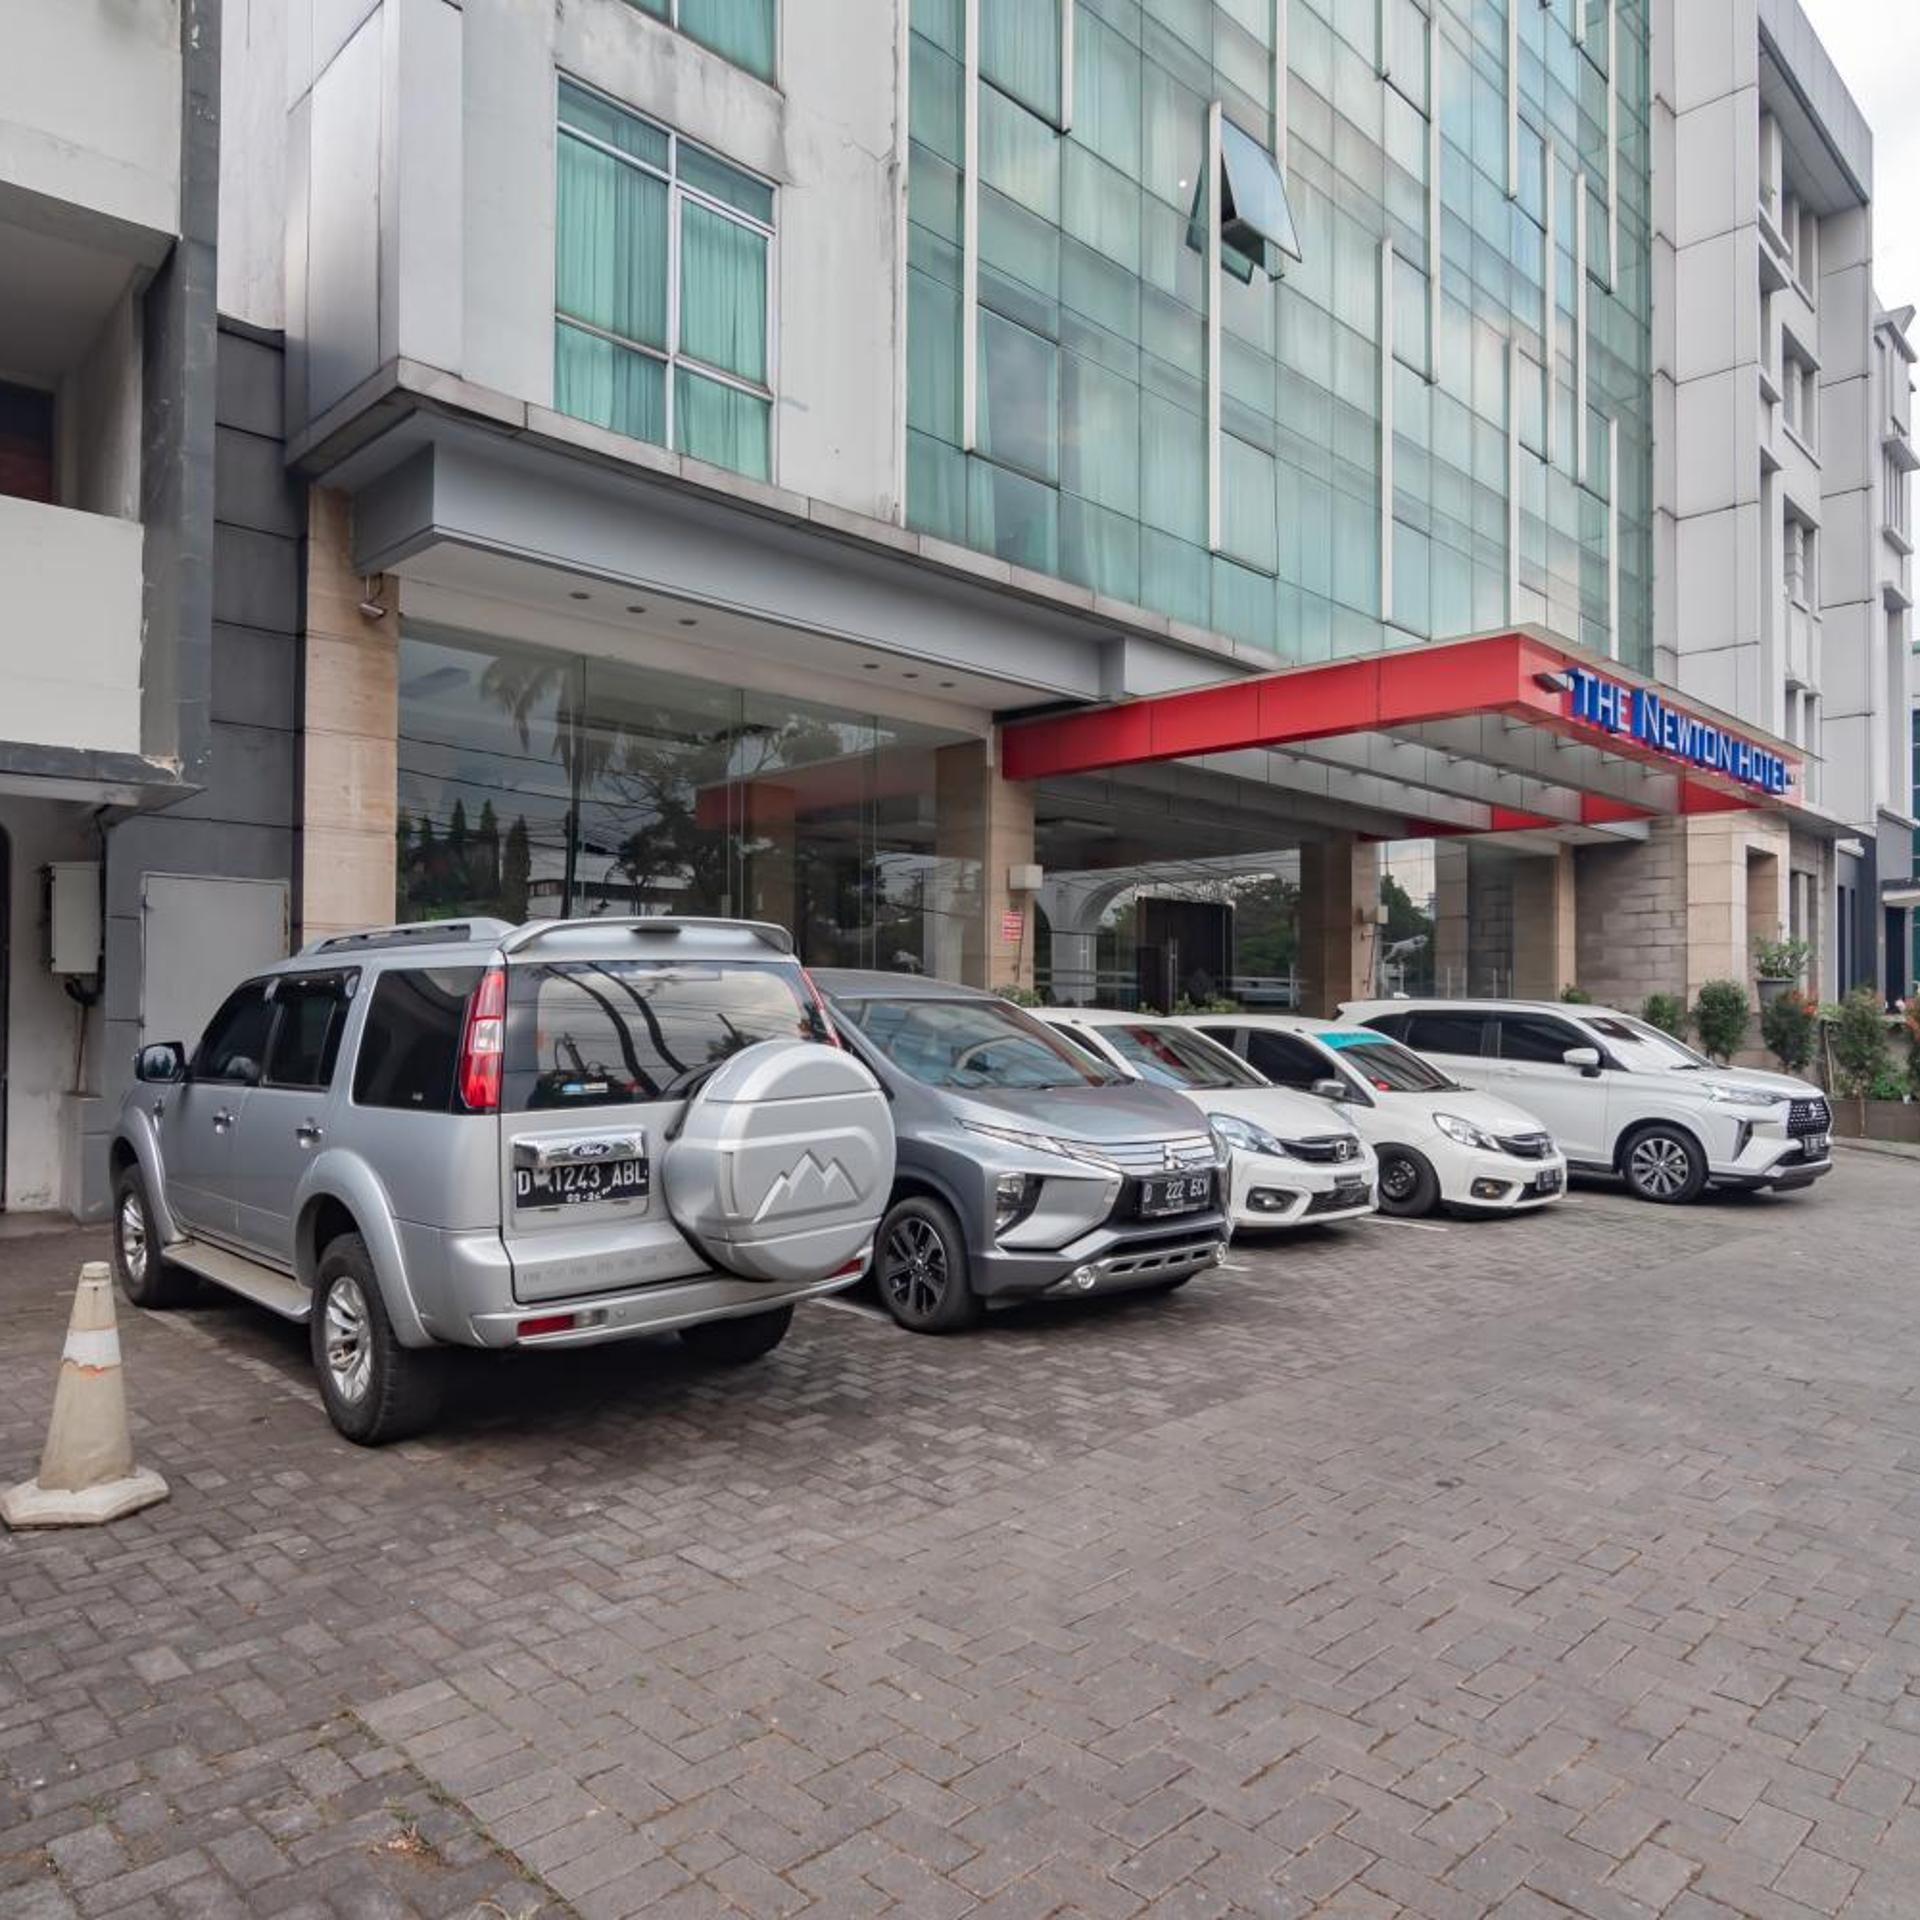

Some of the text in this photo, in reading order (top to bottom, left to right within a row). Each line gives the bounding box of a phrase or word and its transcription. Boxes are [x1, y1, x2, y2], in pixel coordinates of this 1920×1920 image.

[1573, 667, 1793, 795] THE NEWTON HOTEL
[517, 1161, 646, 1195] D 1243 ABL
